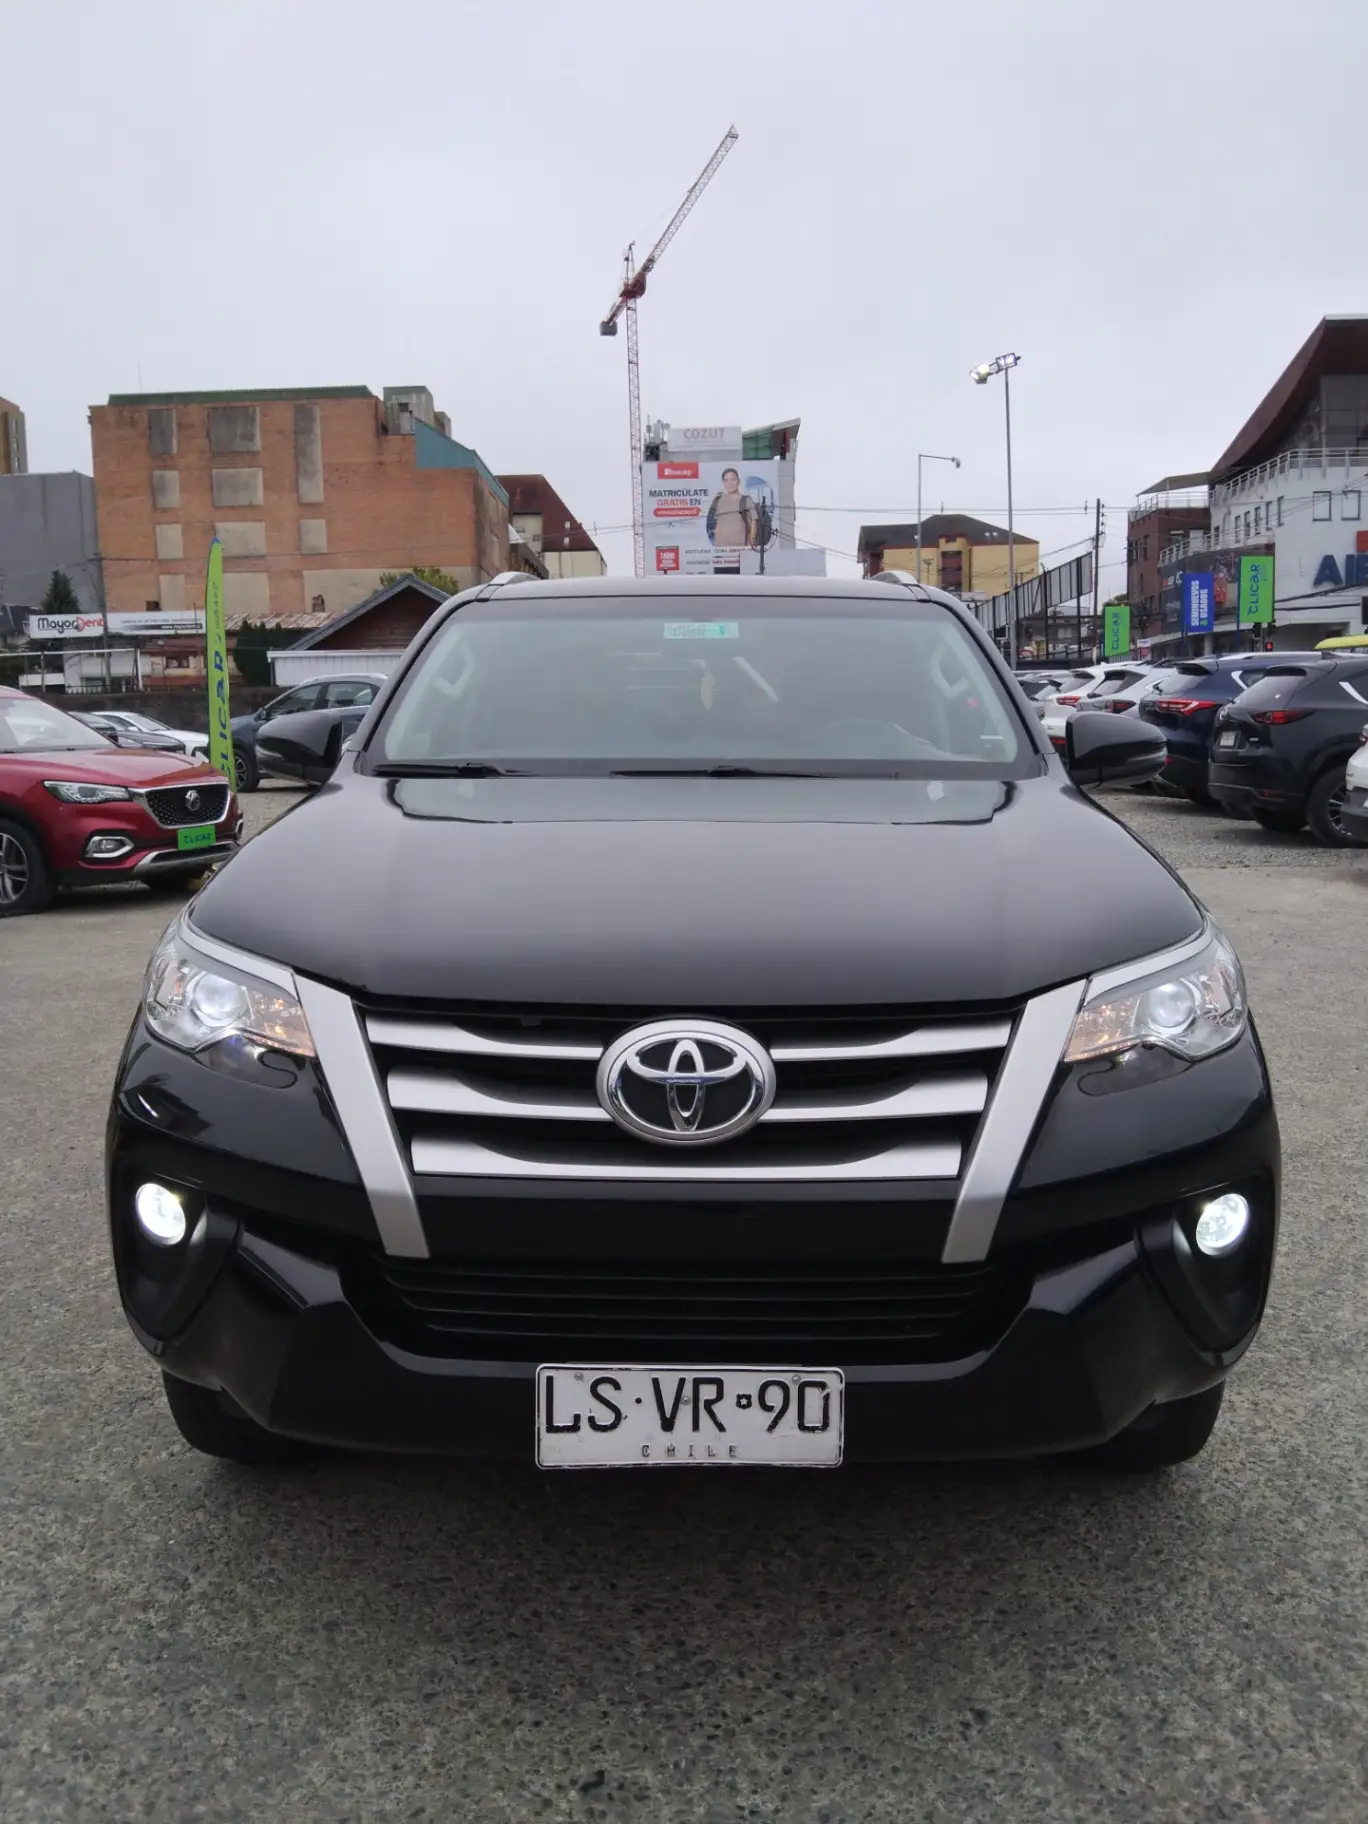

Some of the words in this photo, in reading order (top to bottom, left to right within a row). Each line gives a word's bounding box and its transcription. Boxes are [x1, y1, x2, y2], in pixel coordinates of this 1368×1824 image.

[683, 428, 726, 440] COZUT
[649, 488, 709, 498] MATRICÚLATE
[656, 498, 689, 506] GRATIS
[689, 498, 702, 506] EN
[641, 1443, 739, 1459] CHILE
